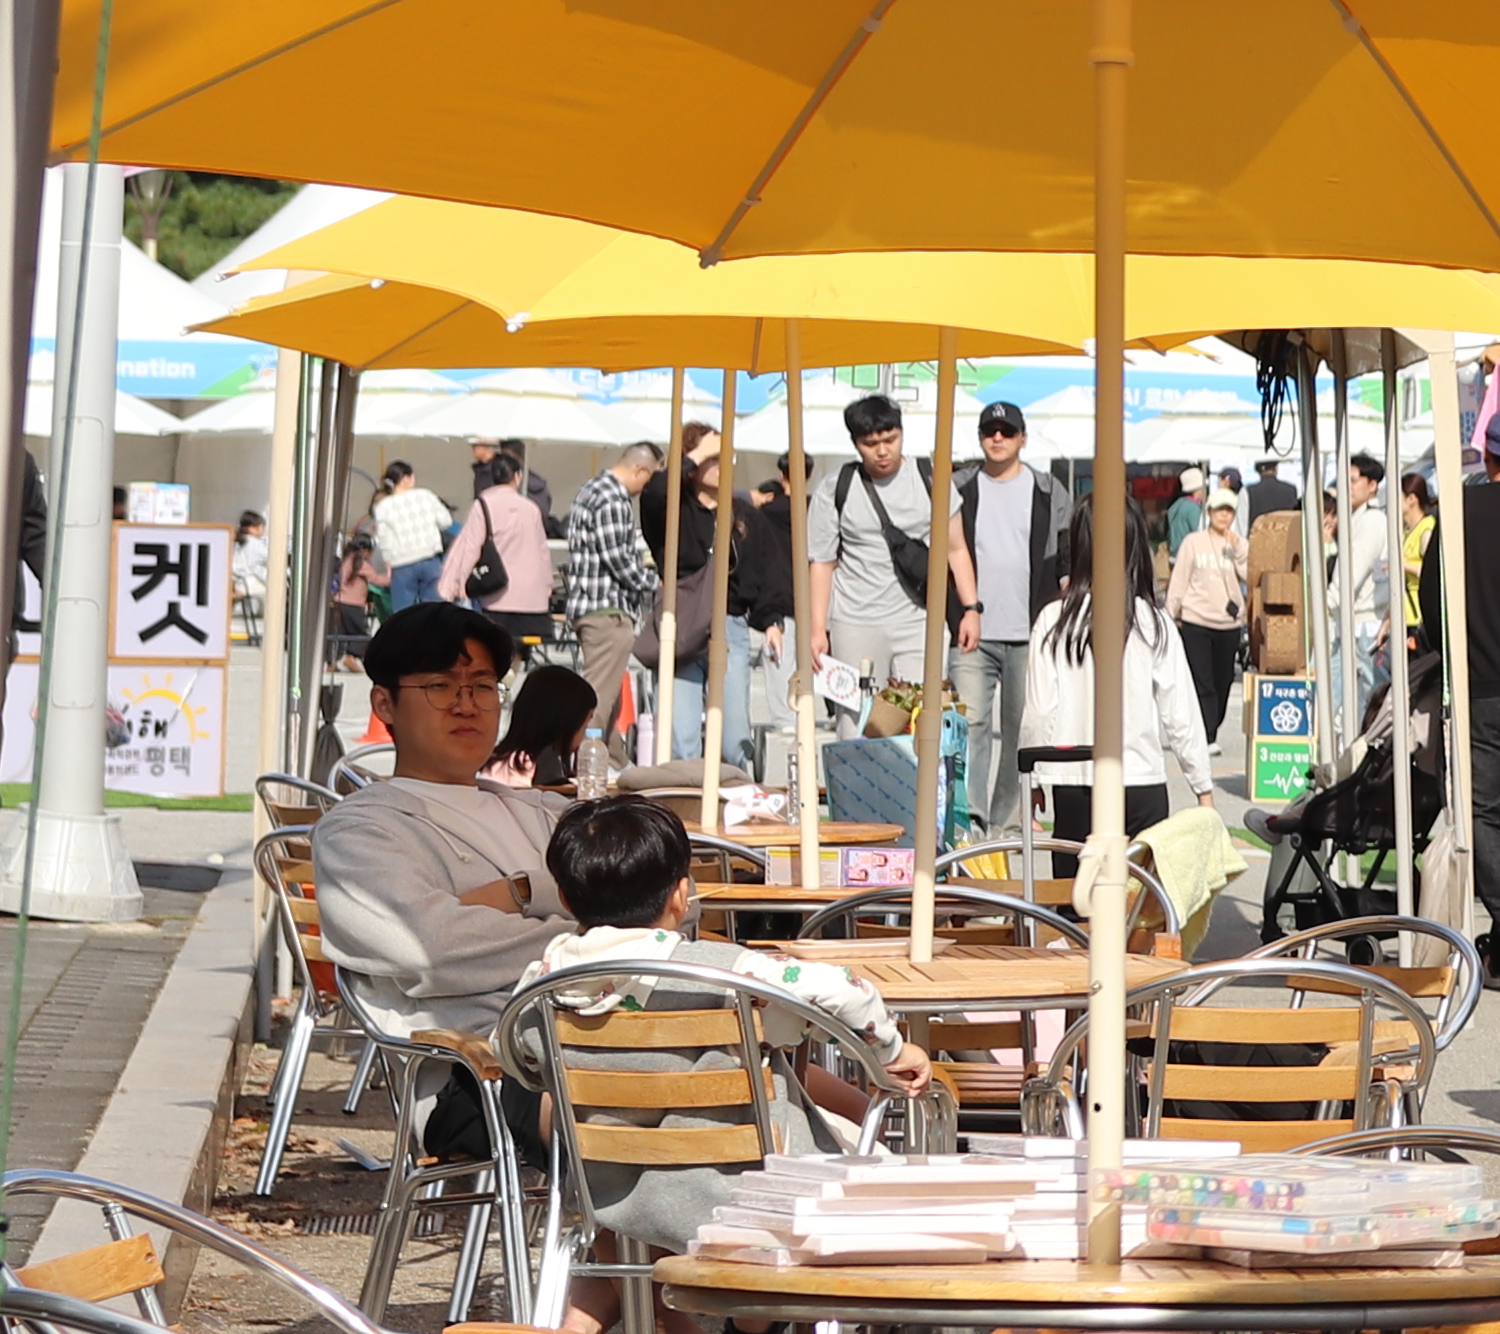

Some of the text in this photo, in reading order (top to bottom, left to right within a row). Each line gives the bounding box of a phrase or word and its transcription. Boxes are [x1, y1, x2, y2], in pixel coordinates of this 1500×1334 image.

[1262, 682, 1274, 699] 17
[146, 745, 192, 777] 평택
[1260, 746, 1269, 763] 3
